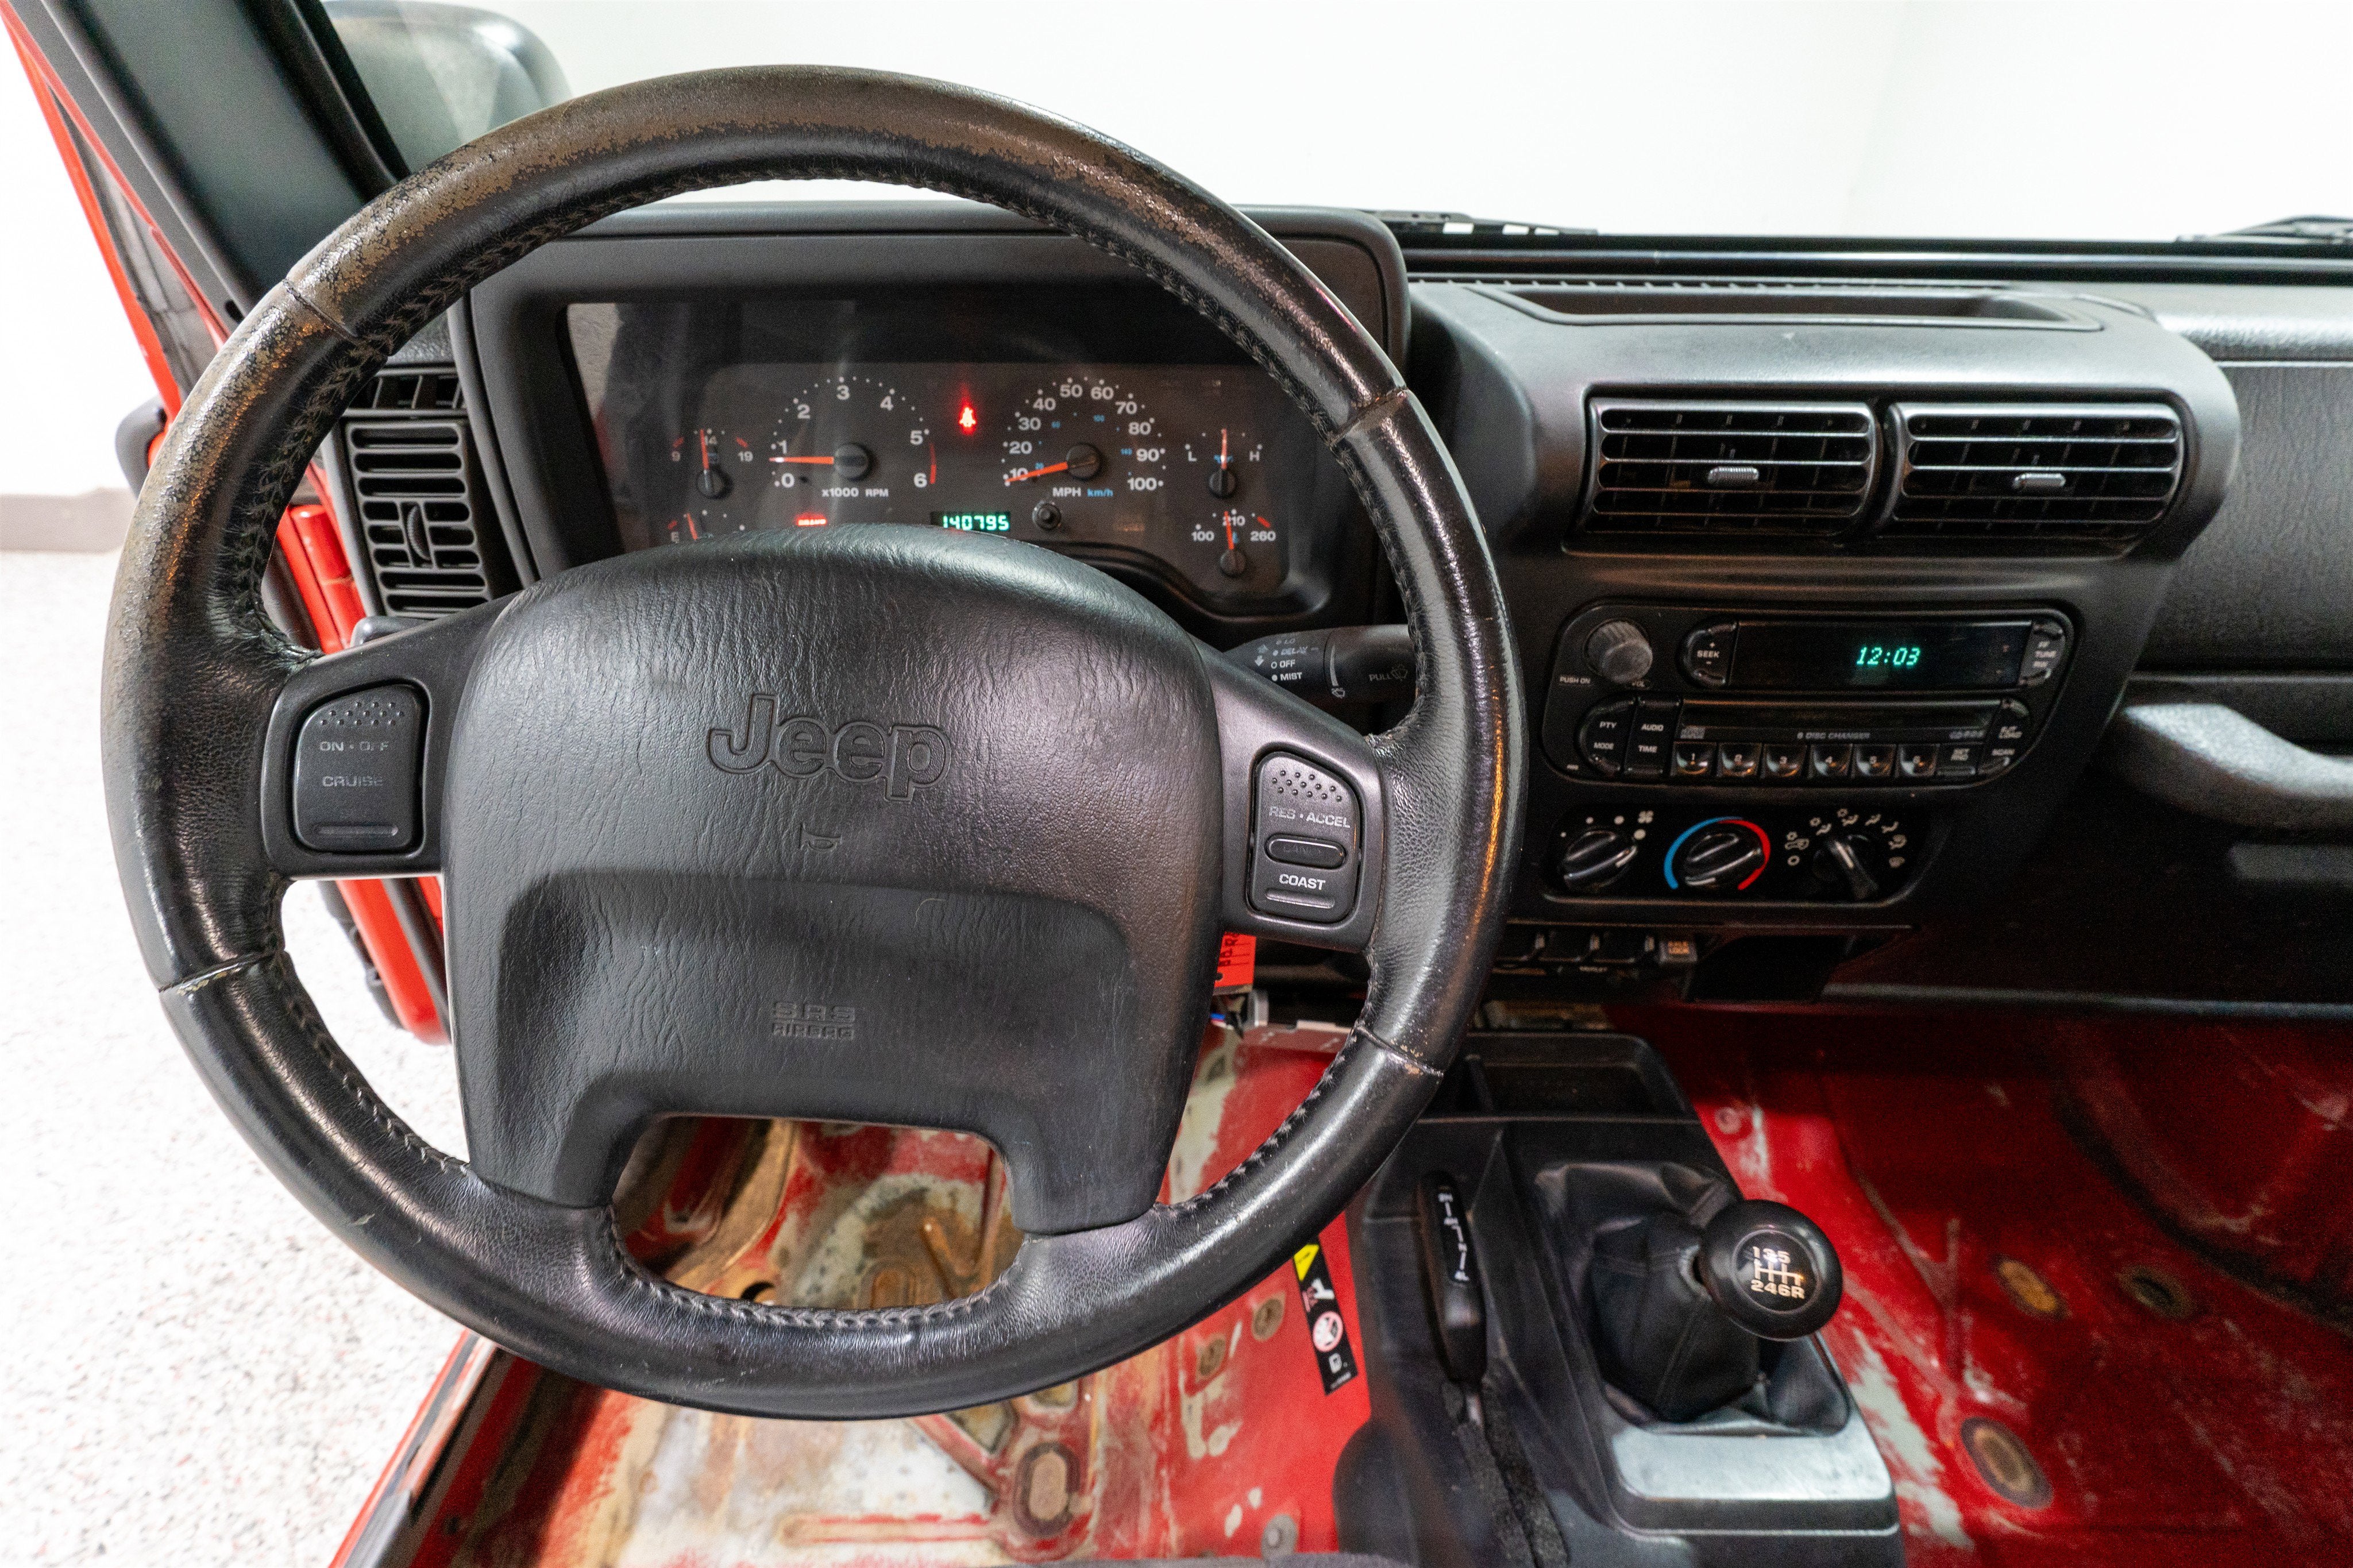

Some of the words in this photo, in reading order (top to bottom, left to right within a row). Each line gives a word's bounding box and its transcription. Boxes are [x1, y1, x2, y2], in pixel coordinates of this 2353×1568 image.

[836, 384, 850, 400] 3
[1060, 384, 1083, 397] 50
[1091, 387, 1114, 400] 60
[880, 395, 894, 411] 4
[1033, 397, 1056, 411] 40
[1115, 401, 1137, 414] 70
[797, 404, 811, 419] 2
[1018, 417, 1041, 431] 30
[1128, 422, 1151, 435] 80
[910, 430, 923, 445] 5
[778, 440, 788, 454] 1
[1009, 441, 1032, 454] 20
[671, 451, 681, 462] 9
[738, 451, 753, 462] 19
[1136, 449, 1159, 461] 90
[1188, 451, 1197, 462] L
[1249, 451, 1260, 461] H
[781, 473, 794, 488] 0
[914, 473, 927, 488] 6
[1009, 468, 1028, 481] 10
[1128, 477, 1157, 491] 100
[821, 487, 859, 497] x1000
[865, 488, 889, 497] RPM
[1052, 487, 1081, 497] MPH
[1087, 488, 1113, 497] km/h
[943, 515, 1009, 531] 140795
[1191, 531, 1215, 542] 100
[1251, 531, 1276, 542] 260
[1697, 650, 1719, 658] SEEK
[1856, 647, 1920, 666] 12:03
[1279, 659, 1296, 668] OFF
[1280, 672, 1302, 681] MIST
[1369, 673, 1390, 681] PULL
[1641, 724, 1664, 732] AUDIO
[319, 741, 344, 751] ON
[707, 694, 951, 802] Jeep
[1594, 742, 1614, 750] MODE
[1638, 745, 1658, 753] TIME
[1269, 806, 1295, 820] RES
[1306, 812, 1351, 828] ACCEL
[1279, 874, 1326, 890] COAST
